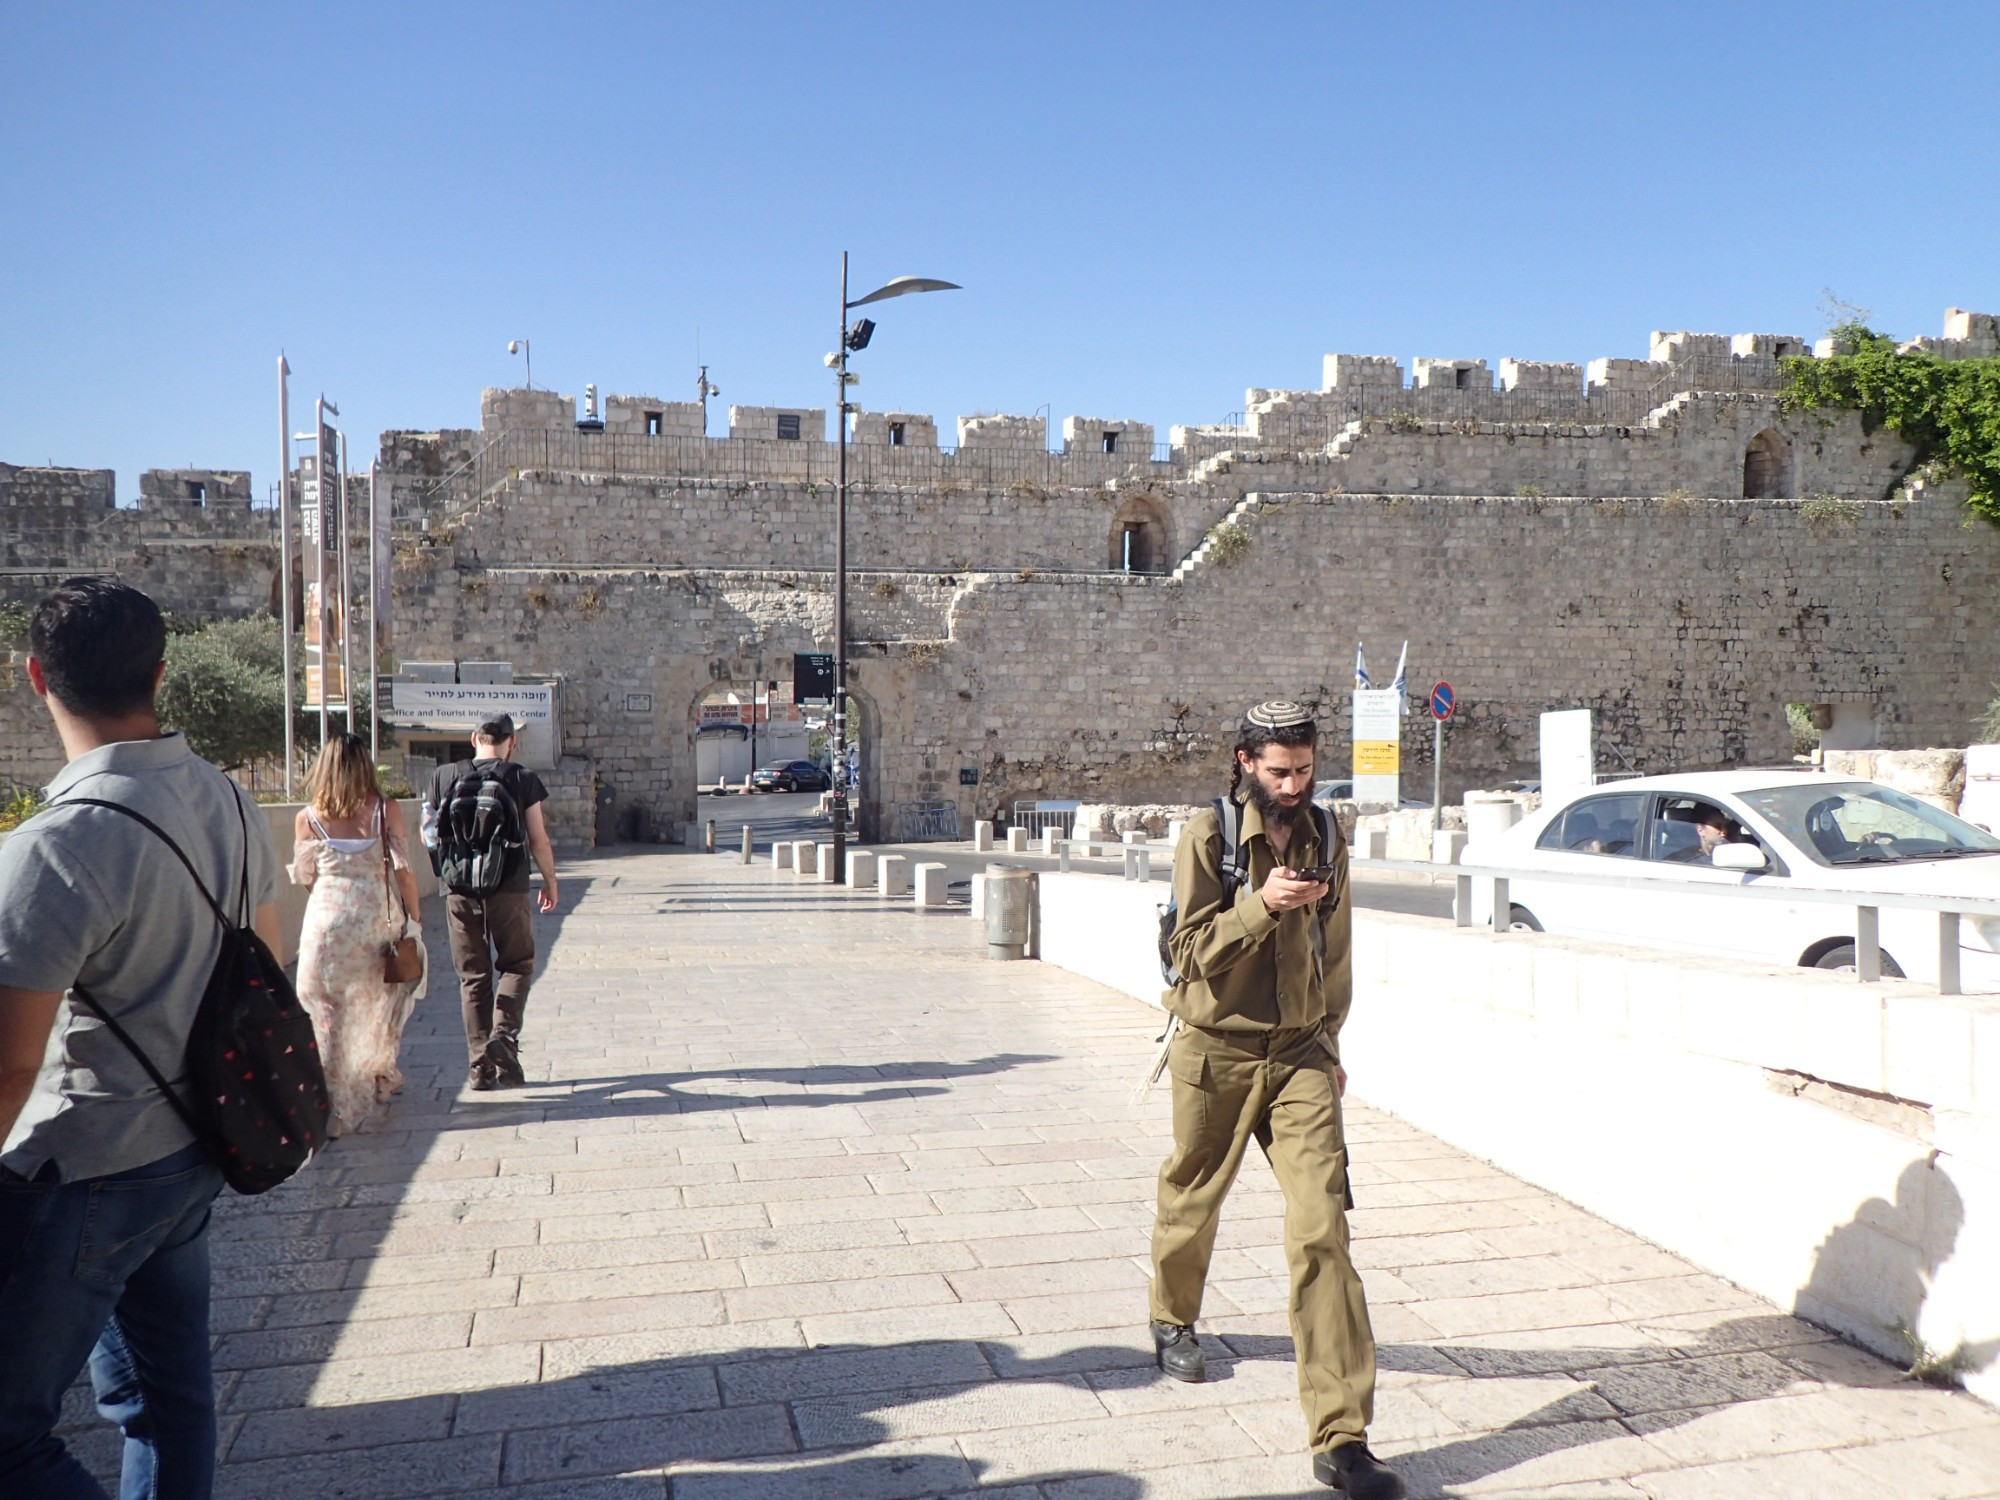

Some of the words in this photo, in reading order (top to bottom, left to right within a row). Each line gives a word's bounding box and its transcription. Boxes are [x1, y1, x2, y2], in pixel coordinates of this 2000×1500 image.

[424, 689, 455, 698] לתייר
[456, 690, 485, 699] מידע
[521, 691, 547, 702] קופה
[417, 709, 433, 717] and
[436, 709, 466, 717] Tourist
[520, 710, 547, 718] Center
